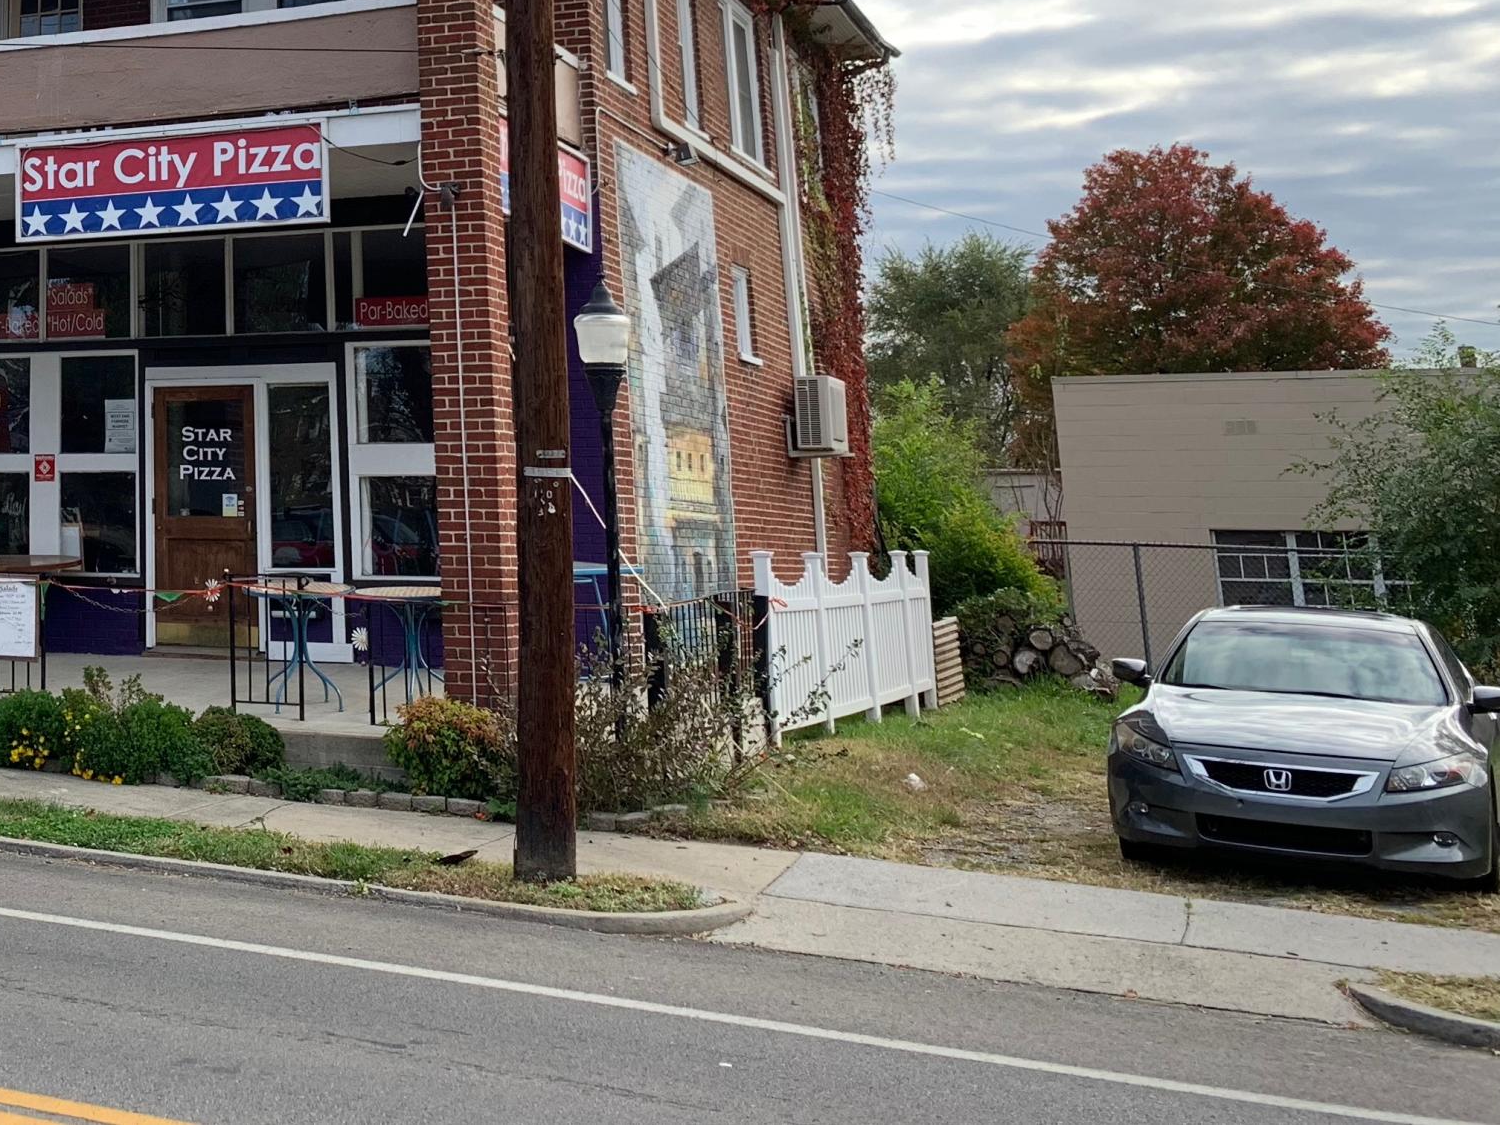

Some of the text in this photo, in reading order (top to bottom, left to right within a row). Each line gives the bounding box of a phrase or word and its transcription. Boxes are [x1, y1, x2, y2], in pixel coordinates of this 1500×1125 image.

[22, 137, 322, 192] Star City Pizza
[558, 156, 587, 204] izza
[361, 299, 429, 320] Par-Baked
[181, 426, 233, 442] STAR
[182, 445, 227, 461] CITY
[179, 464, 237, 481] PIZZA
